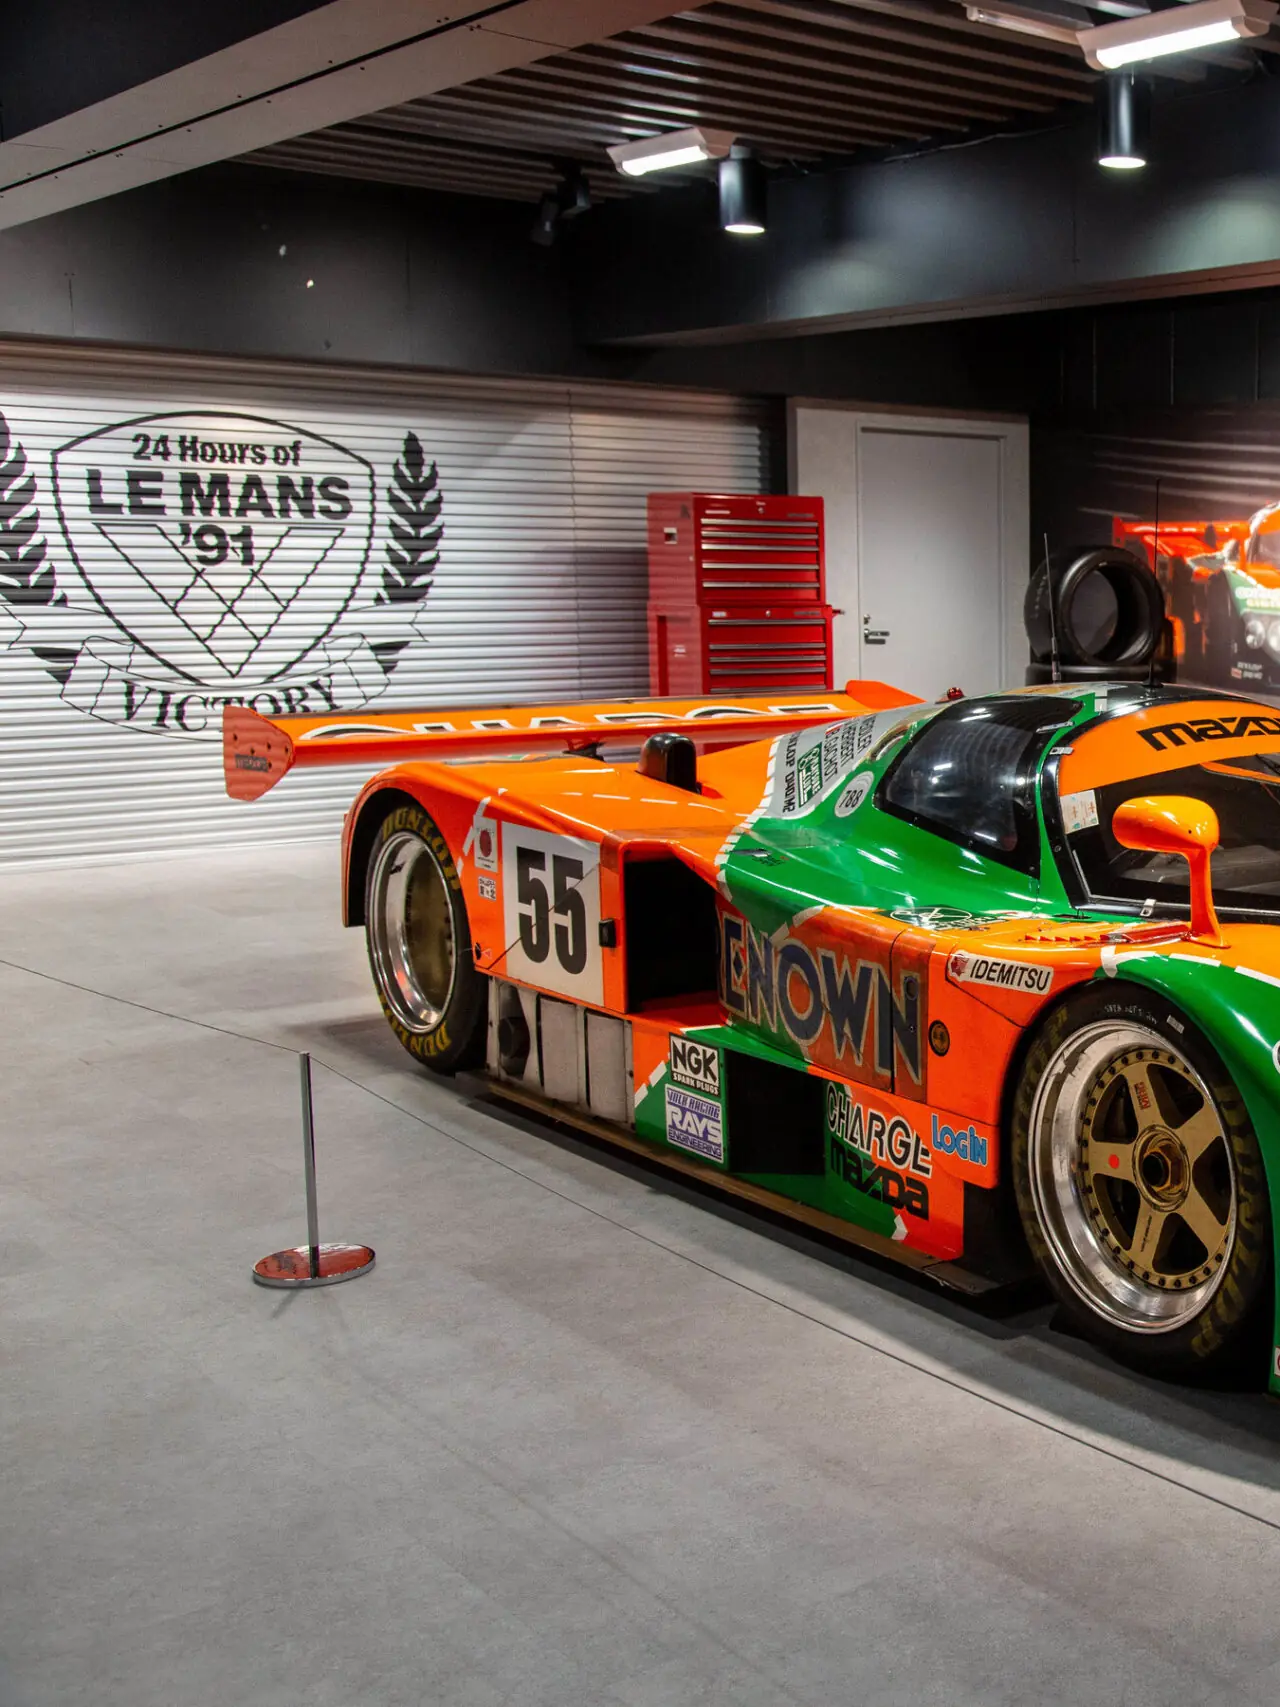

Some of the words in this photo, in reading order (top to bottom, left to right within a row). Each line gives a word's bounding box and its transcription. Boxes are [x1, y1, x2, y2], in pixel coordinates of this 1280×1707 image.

[132, 434, 172, 461] 24
[179, 436, 268, 465] Hours
[273, 440, 303, 466] of
[86, 469, 167, 517] LE
[179, 472, 354, 520] MANS
[121, 673, 344, 732] VICORY
[516, 846, 588, 975] 55
[718, 911, 922, 1086] ENOWN
[969, 958, 1051, 993] IDEMITSU
[672, 1040, 718, 1083] NGK
[696, 1079, 719, 1096] PLUGS
[668, 1106, 722, 1144] RAYS
[668, 1127, 722, 1157] ENGINEERING
[826, 1081, 933, 1179] CHARGE
[830, 1136, 930, 1221] mazda
